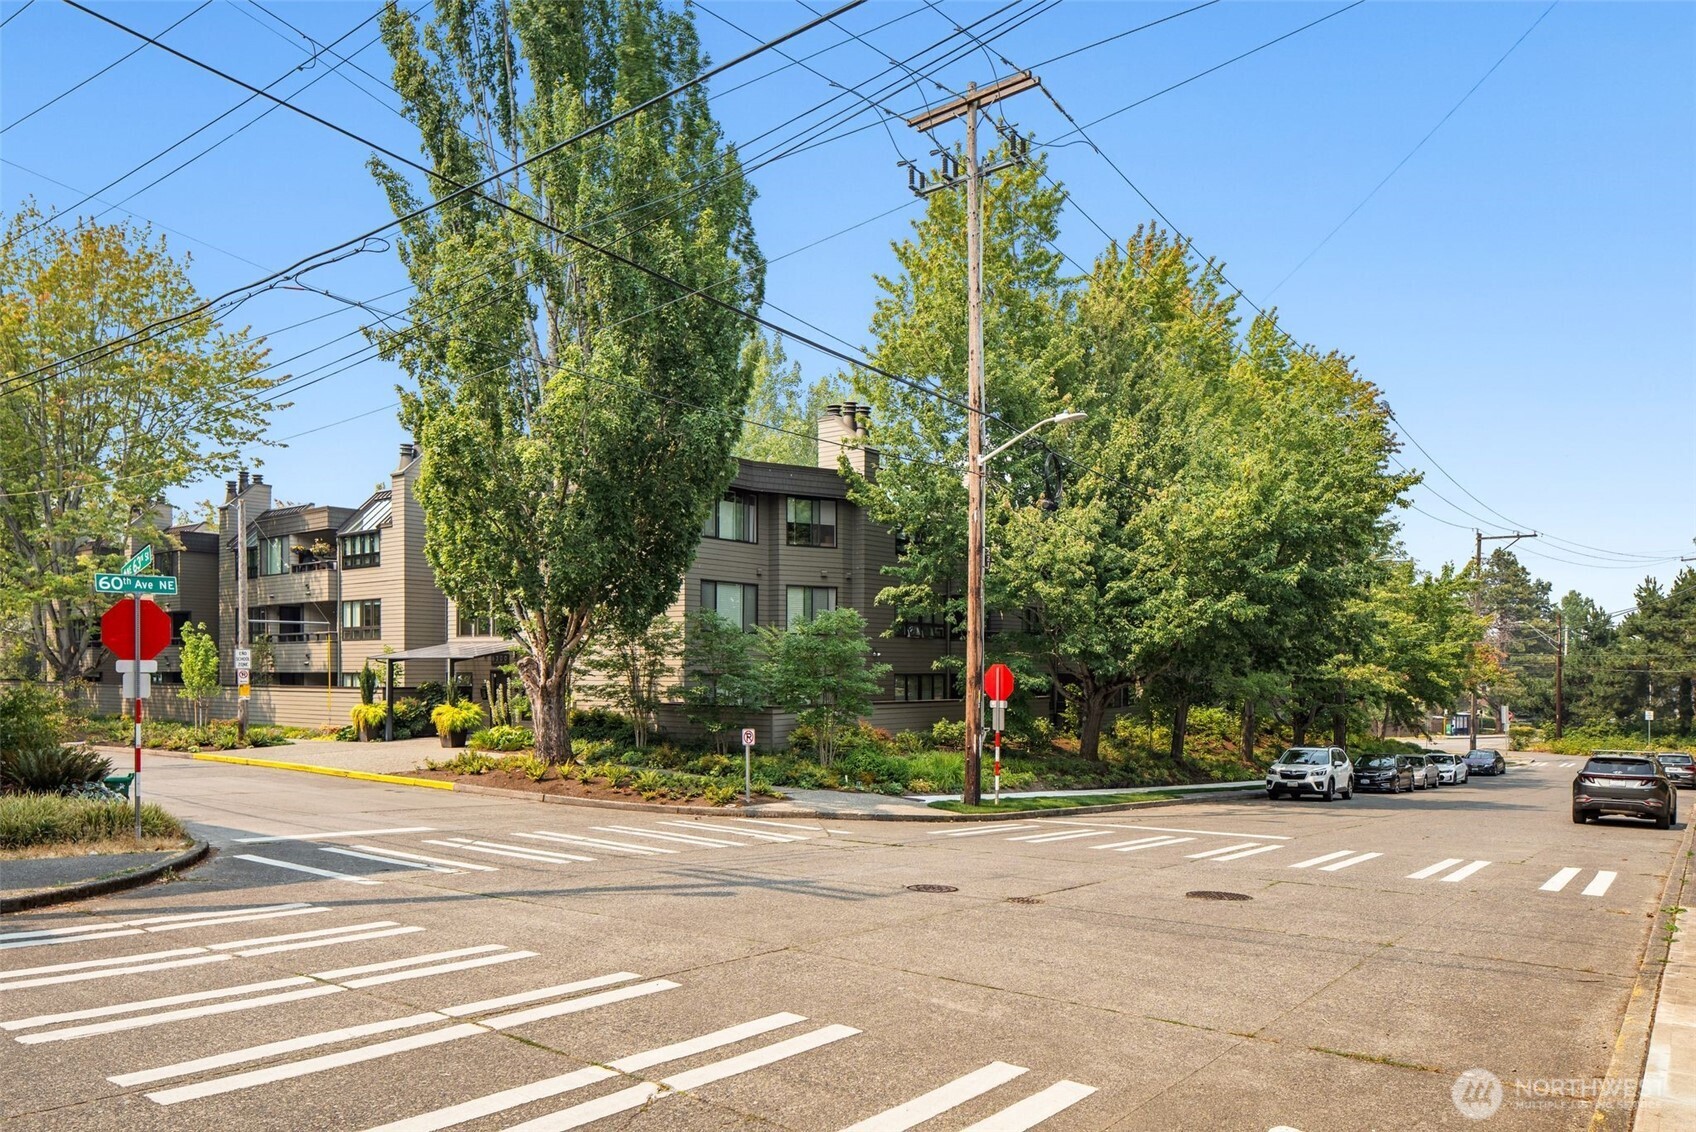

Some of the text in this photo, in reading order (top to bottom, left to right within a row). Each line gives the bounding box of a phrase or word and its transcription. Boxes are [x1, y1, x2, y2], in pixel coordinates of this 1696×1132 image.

[99, 576, 175, 590] 60th Ave NE
